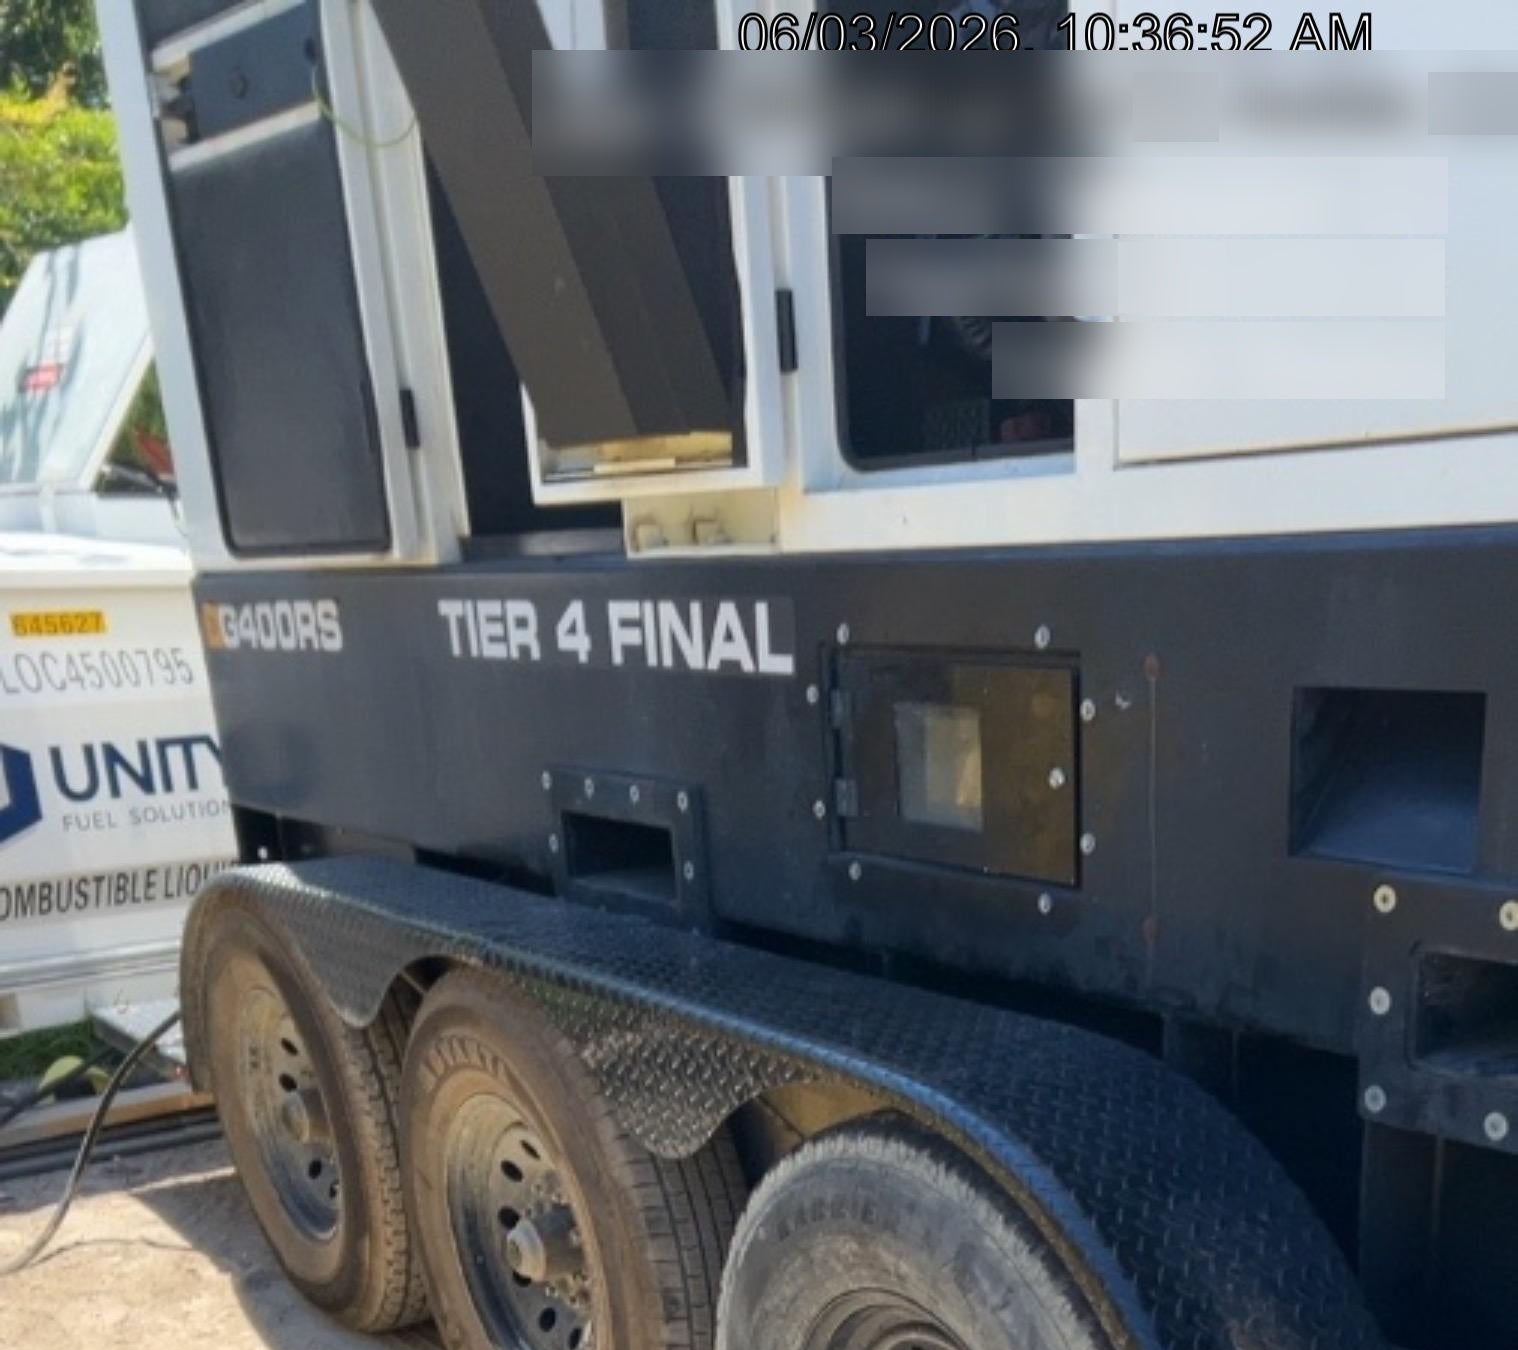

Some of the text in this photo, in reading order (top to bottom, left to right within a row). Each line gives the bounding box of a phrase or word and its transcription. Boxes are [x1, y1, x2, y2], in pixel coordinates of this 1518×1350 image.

[437, 599, 794, 675] TIER 4 FINAL
[0, 647, 194, 695] LOC4500795
[62, 811, 118, 832] FUEL
